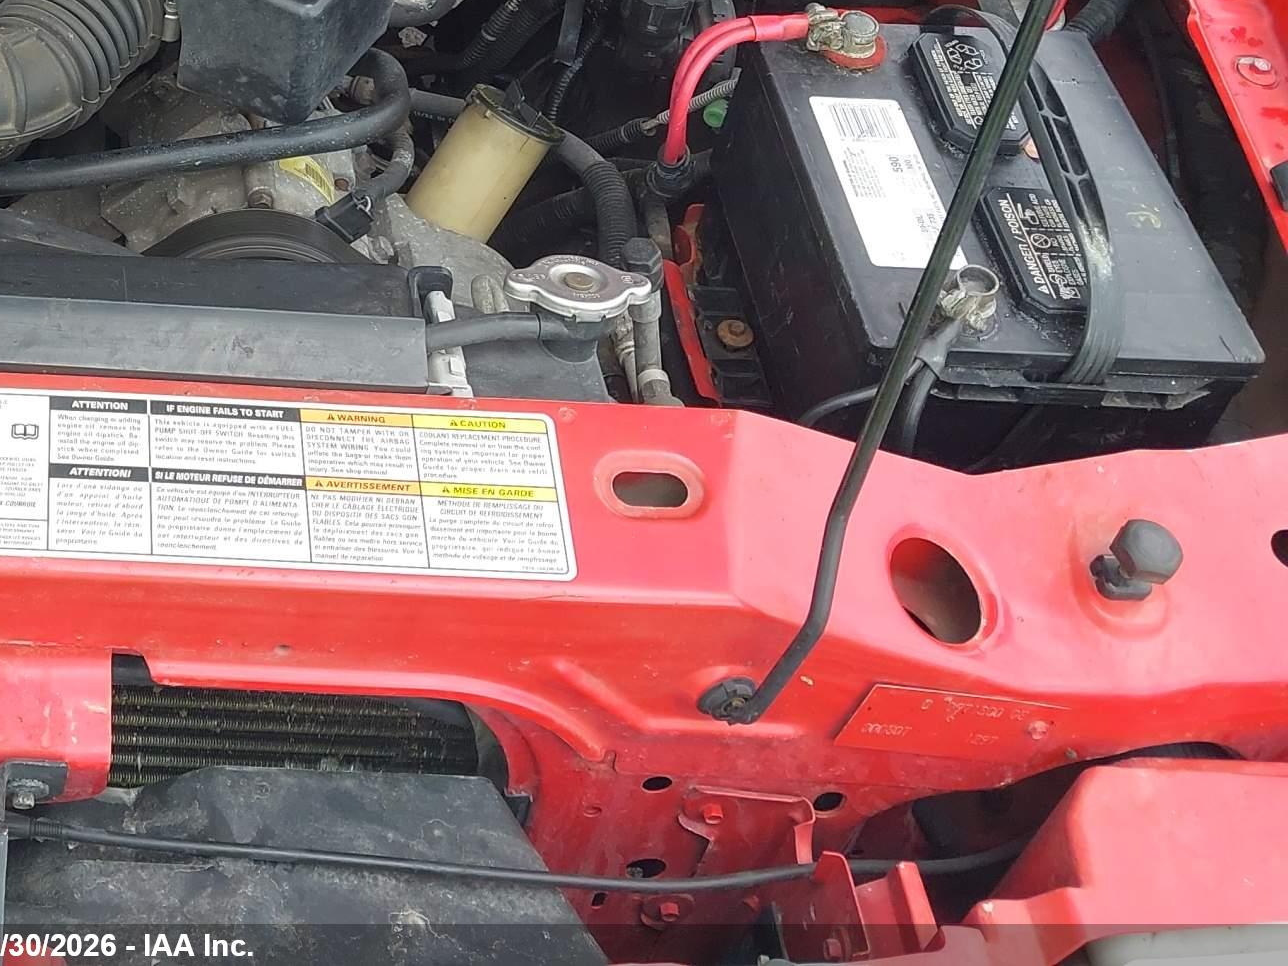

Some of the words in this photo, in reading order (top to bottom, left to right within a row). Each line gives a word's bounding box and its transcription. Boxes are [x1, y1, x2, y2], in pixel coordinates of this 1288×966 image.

[998, 199, 1022, 234] POISON
[72, 400, 128, 410] ATTENTION
[177, 405, 210, 414] ENGINE
[213, 407, 238, 416] FAILS
[240, 408, 253, 417] TO
[255, 409, 284, 418] START
[337, 414, 385, 423] WARNING
[460, 420, 506, 429] CAUTION
[452, 433, 499, 441] REPLACEMENT
[306, 441, 337, 449] SYSTEM
[70, 467, 131, 477] ATTENTION!
[165, 472, 174, 480] LE
[176, 473, 210, 482] MOTEUR
[212, 474, 243, 484] REFUSE
[245, 476, 256, 484] DE
[258, 475, 302, 486] DÉMARRER
[327, 481, 410, 491] AVERTISSEMENT
[453, 487, 478, 495] MISE
[498, 489, 534, 498] GARDE
